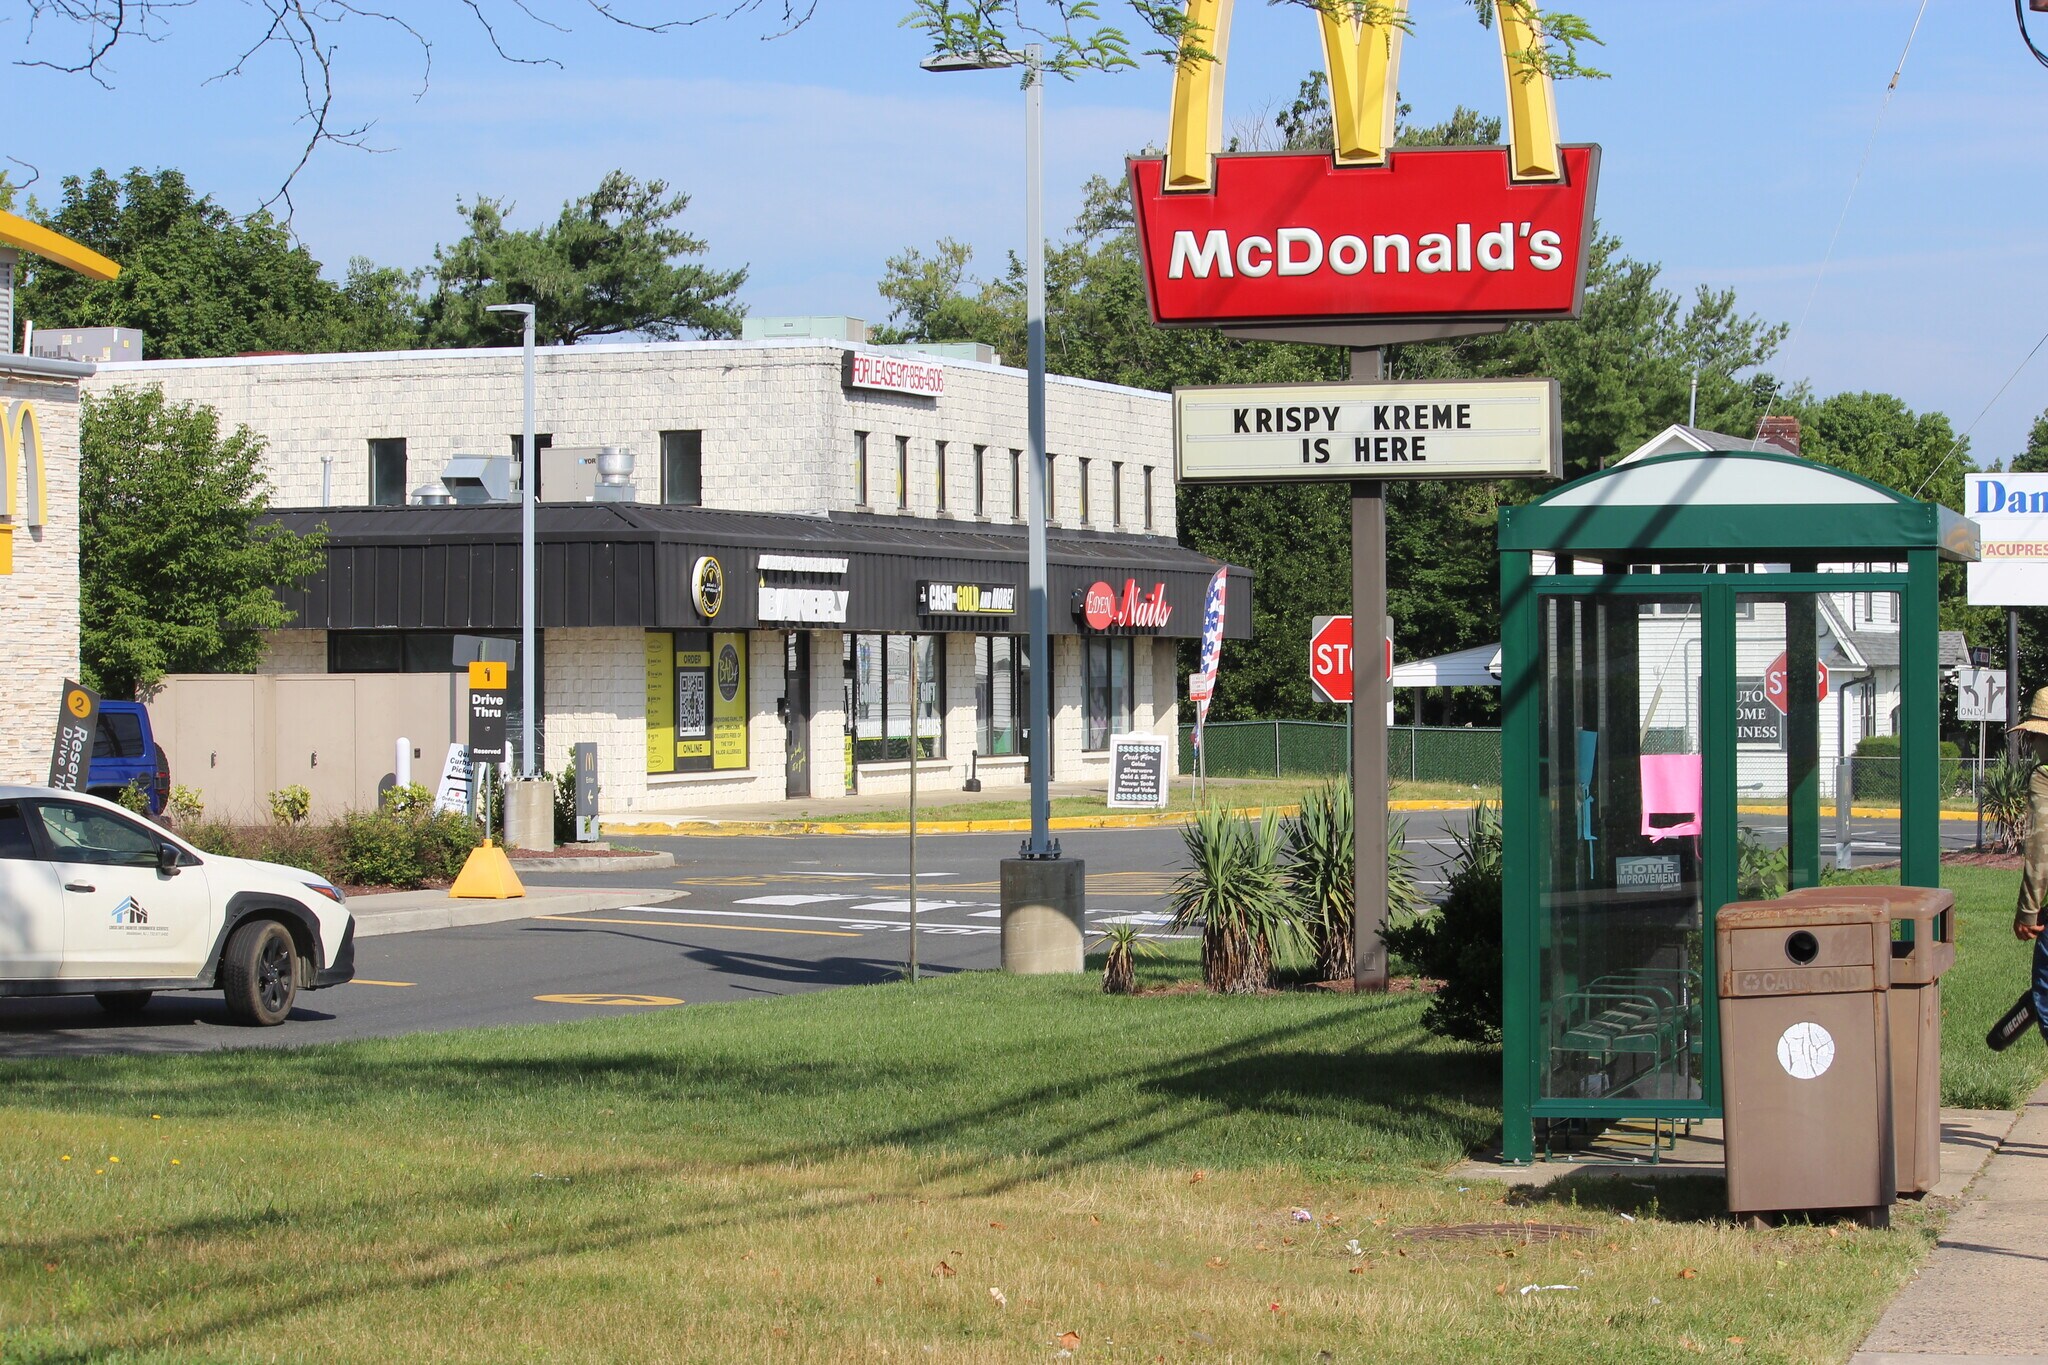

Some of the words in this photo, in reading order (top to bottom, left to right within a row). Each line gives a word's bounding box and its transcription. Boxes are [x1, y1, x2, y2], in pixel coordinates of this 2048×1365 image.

[1168, 222, 1563, 279] McDonald's
[852, 357, 870, 384] FOR
[870, 358, 896, 387] LEASE
[1233, 405, 1340, 434] KRISPY
[1373, 403, 1471, 430] KREME
[1302, 437, 1330, 464] IS
[1355, 435, 1426, 462] HERE
[929, 584, 953, 611] CASH
[957, 585, 979, 611] GOLD
[991, 587, 1014, 609] MORE!
[1118, 579, 1172, 627] Nails
[684, 655, 702, 664] ORDER
[1316, 643, 1352, 675] ST
[484, 668, 491, 682] 1
[472, 693, 504, 706] Drive
[1736, 690, 1763, 703] UTO
[74, 696, 84, 712] 2
[1961, 706, 1984, 716] ONLY
[473, 707, 502, 718] Thru
[1736, 707, 1766, 720] OME
[1737, 726, 1777, 738] INESS
[57, 726, 73, 767] Drive
[682, 744, 703, 753] ONLINE
[65, 725, 88, 792] Reserv
[1620, 864, 1674, 874] HOME
[1617, 872, 1680, 885] IMPROVEMENT
